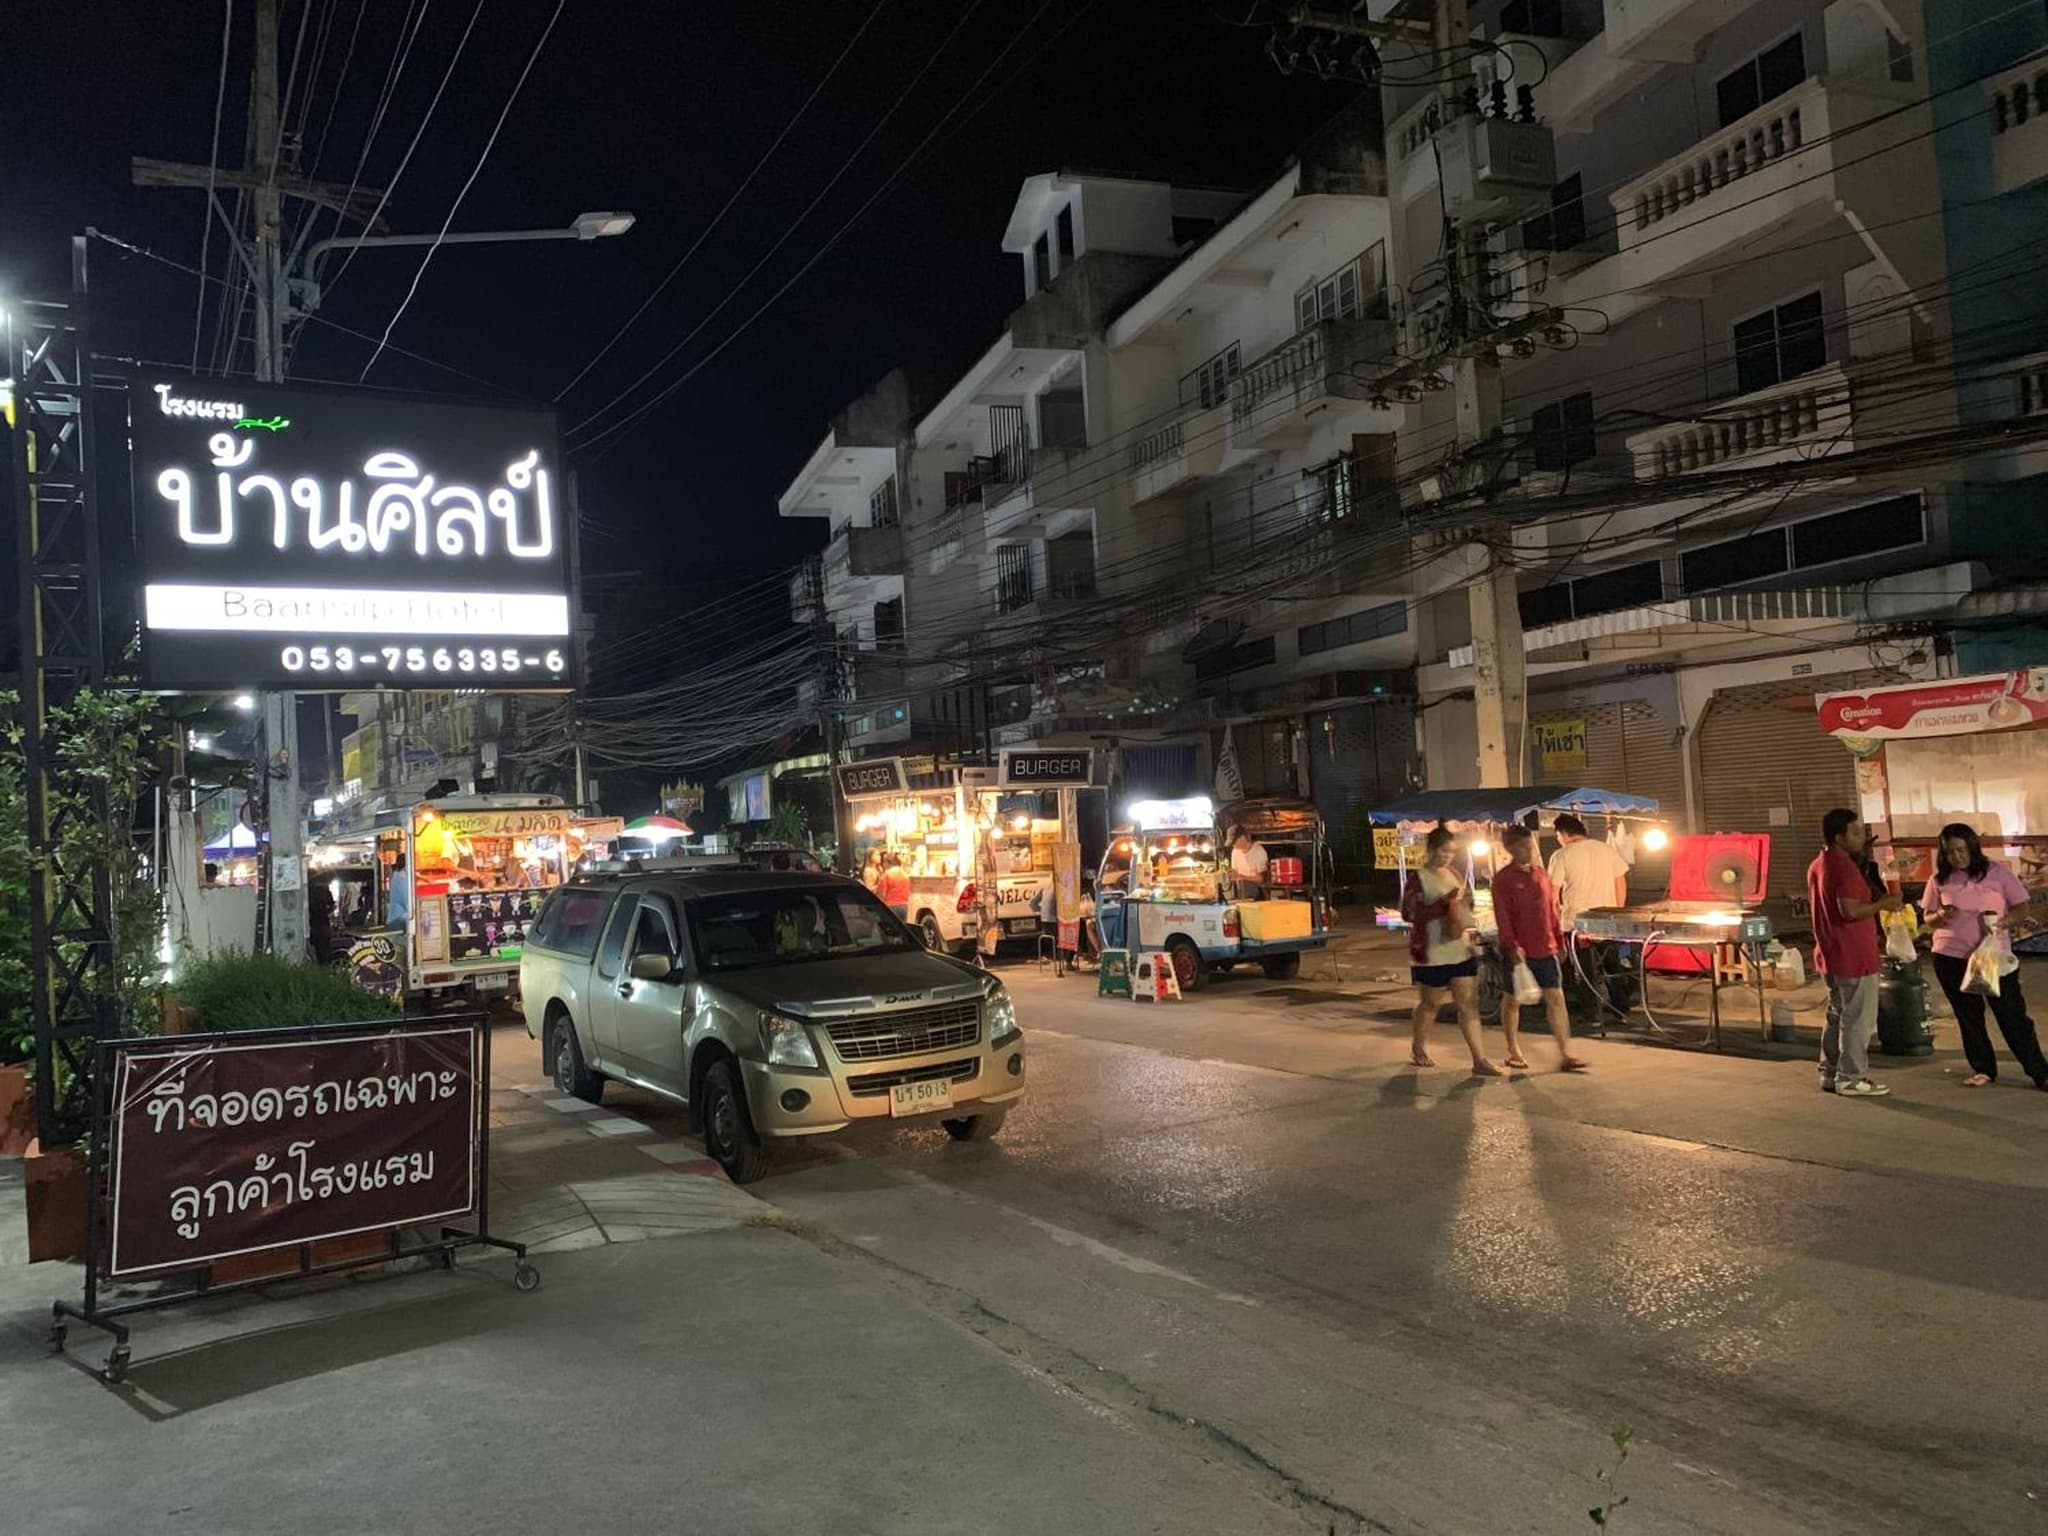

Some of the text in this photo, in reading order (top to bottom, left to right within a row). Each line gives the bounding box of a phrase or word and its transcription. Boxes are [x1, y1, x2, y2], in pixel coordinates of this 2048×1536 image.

[154, 384, 243, 421] โรงแรม
[157, 432, 553, 558] บ้านศิลป์
[281, 645, 565, 673] 053-756335-6
[1535, 726, 1584, 753] ให้เช่า
[847, 767, 893, 791] BURGER
[1014, 759, 1081, 777] BURGER
[146, 1066, 457, 1134] ที่จอดรถเฉพาะ
[917, 1081, 948, 1099] 5013
[169, 1140, 434, 1240] ลูกค้าโรงแรม
